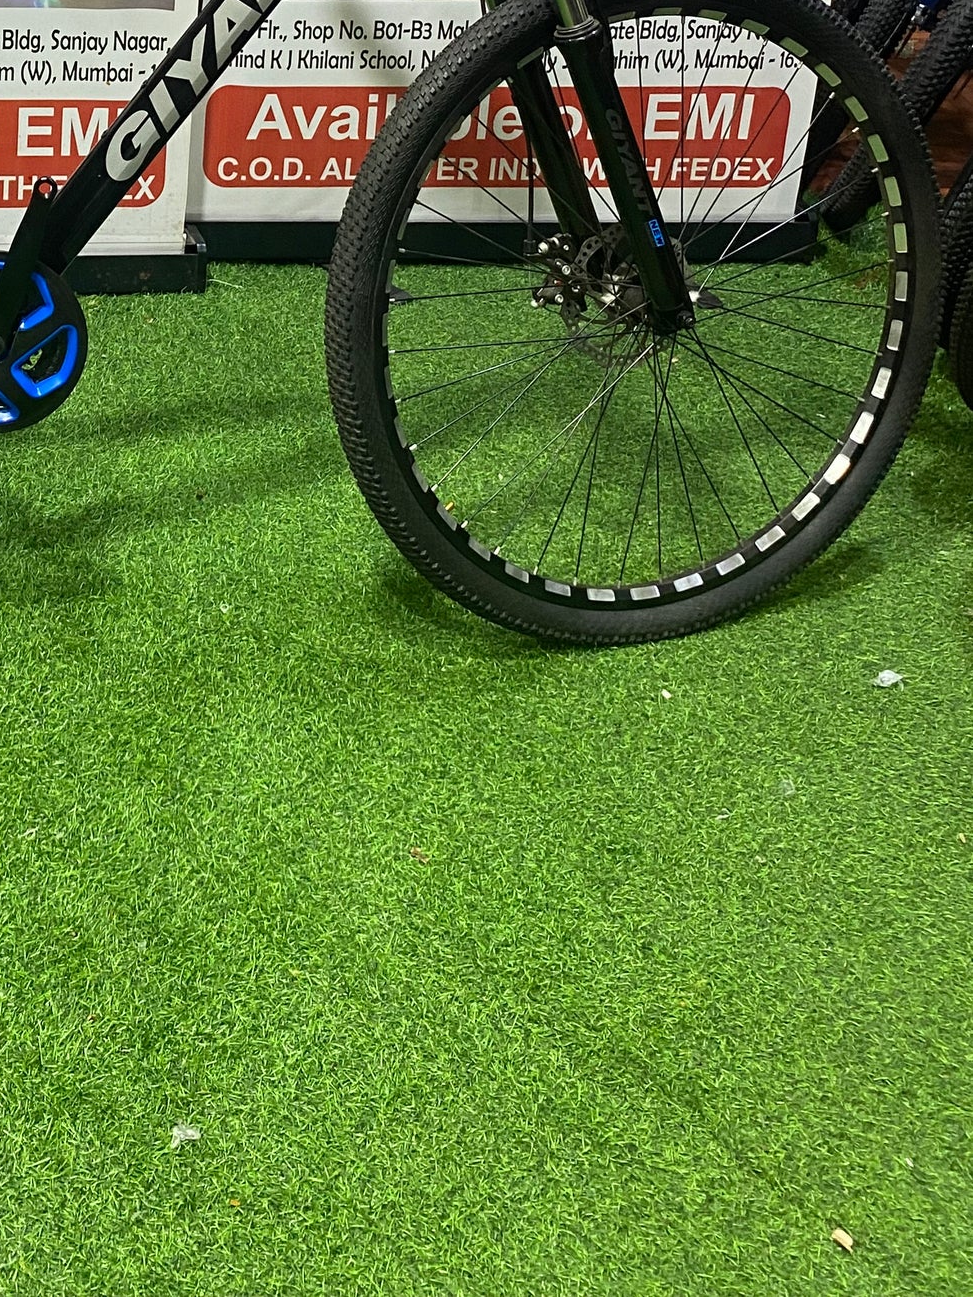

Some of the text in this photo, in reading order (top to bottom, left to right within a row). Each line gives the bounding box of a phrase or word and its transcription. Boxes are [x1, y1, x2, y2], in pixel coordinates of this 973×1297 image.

[2, 29, 45, 53] Bldg,
[51, 30, 107, 55] Sanjay
[114, 31, 170, 54] Nagar,
[258, 20, 287, 42] Flr.,
[294, 20, 333, 42] Shop
[339, 20, 367, 40] No.
[373, 20, 432, 40] B01-B3
[639, 20, 681, 42] Bldg,
[687, 20, 742, 42] Sanjay
[21, 61, 56, 85] (W),
[62, 62, 133, 82] Mumbai
[271, 50, 281, 69] K
[287, 50, 292, 70] J
[297, 50, 354, 69] Khilani
[359, 50, 415, 71] School,
[655, 50, 689, 72] (W),
[694, 50, 765, 70] Mumbai
[644, 94, 755, 140] EMI
[17, 107, 124, 156] EM
[217, 158, 311, 180] C.O.D.
[671, 158, 775, 181] FEDEX
[650, 220, 664, 246] NEW
